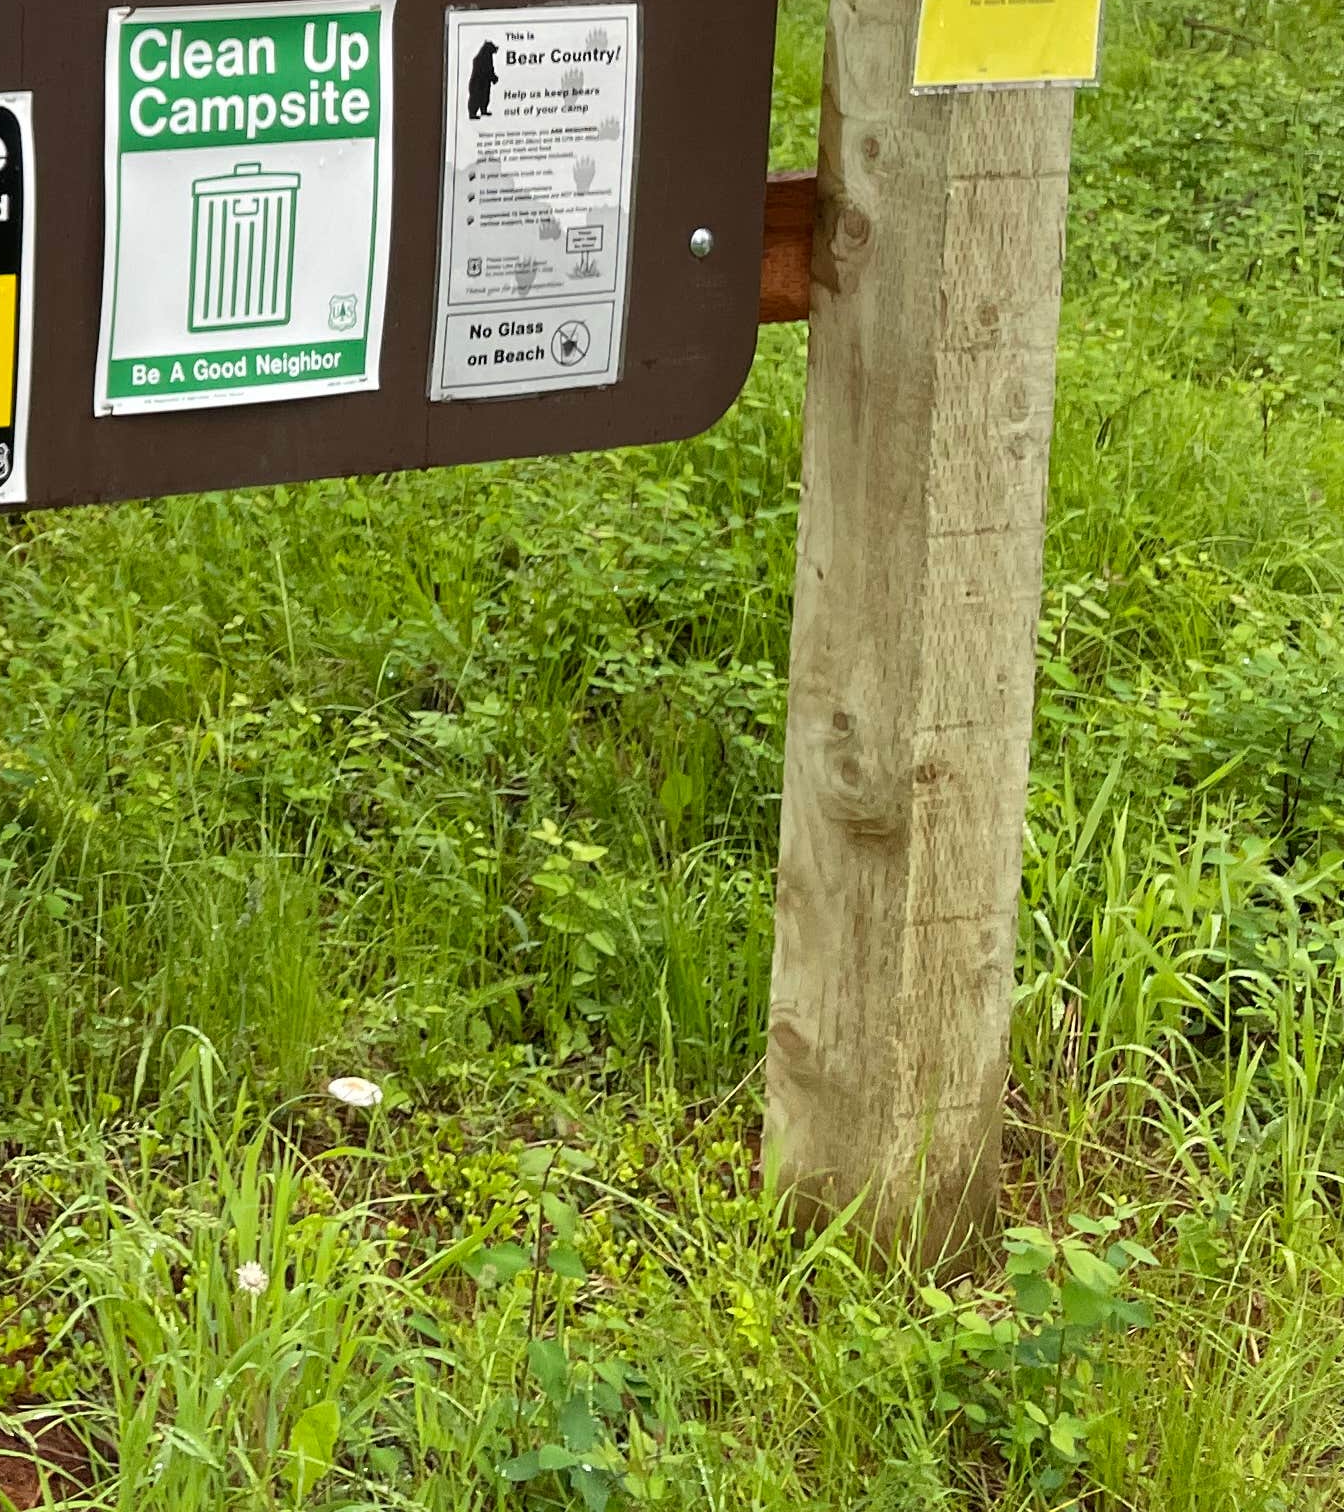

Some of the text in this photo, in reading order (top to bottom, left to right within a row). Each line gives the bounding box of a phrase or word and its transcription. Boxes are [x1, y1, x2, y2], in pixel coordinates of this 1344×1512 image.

[130, 22, 368, 82] Clean Up
[507, 46, 621, 64] Bear Country!
[130, 80, 370, 138] Campsite
[470, 322, 542, 339] No Glass
[468, 346, 544, 365] on Beach
